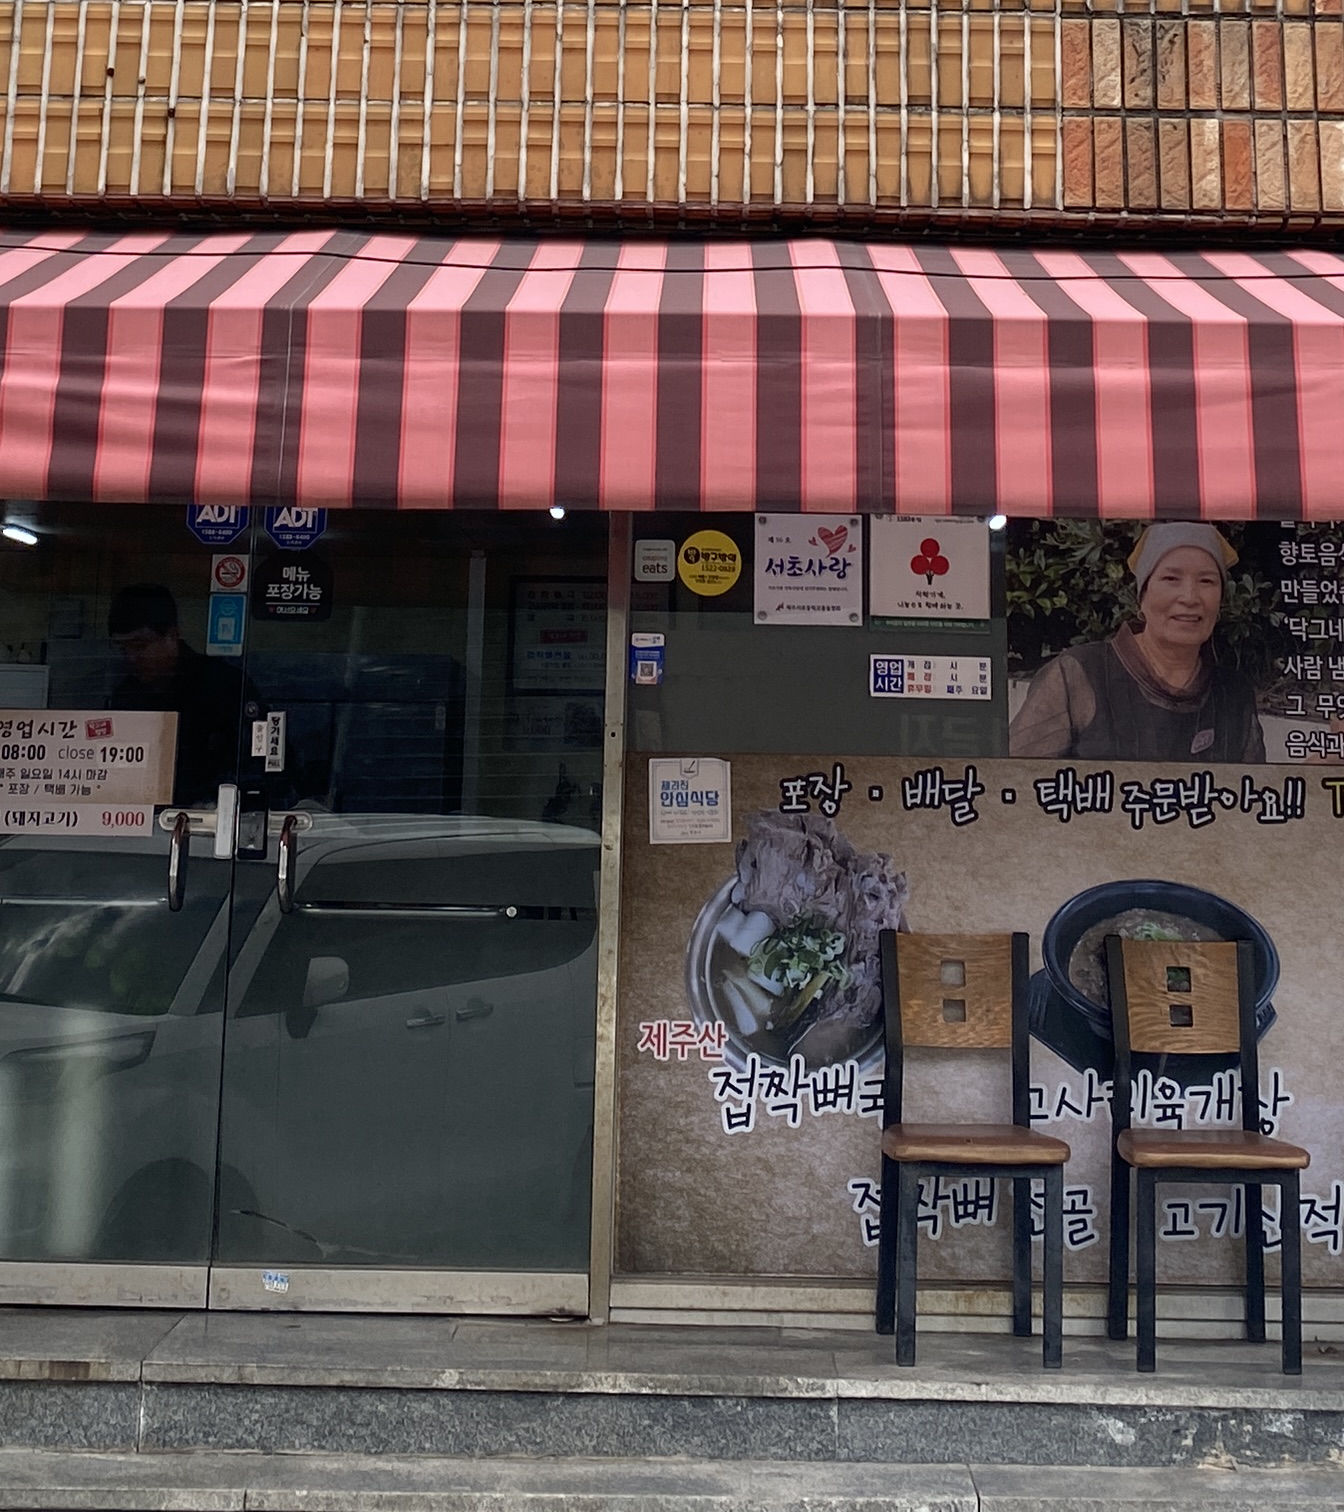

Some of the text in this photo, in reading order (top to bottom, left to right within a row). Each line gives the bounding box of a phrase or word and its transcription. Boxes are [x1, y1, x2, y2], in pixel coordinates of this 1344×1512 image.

[273, 506, 319, 528] ADT
[282, 566, 311, 582] 메뉴
[642, 563, 668, 574] eats
[764, 555, 853, 580] 서초사랑
[265, 582, 323, 600] 포장가능
[875, 660, 902, 676] 영업
[1283, 655, 1324, 681] 사람
[875, 676, 903, 692] 시간
[1285, 694, 1306, 716] 그
[1, 744, 47, 761] 08:00
[57, 745, 95, 760] close
[99, 746, 145, 763] 19:00
[19, 767, 54, 781] 일요일
[57, 768, 83, 781] 14시
[85, 768, 109, 781] 마감
[7, 783, 30, 796] 포장
[43, 783, 67, 796] 택배
[659, 790, 720, 807] 안심식당
[781, 763, 851, 817] 포장
[902, 766, 984, 825] 배달
[1036, 769, 1113, 822] 택배
[1122, 772, 1305, 828] 주문받아요!!
[101, 811, 145, 829] 9,000
[639, 1021, 727, 1060] 제주산
